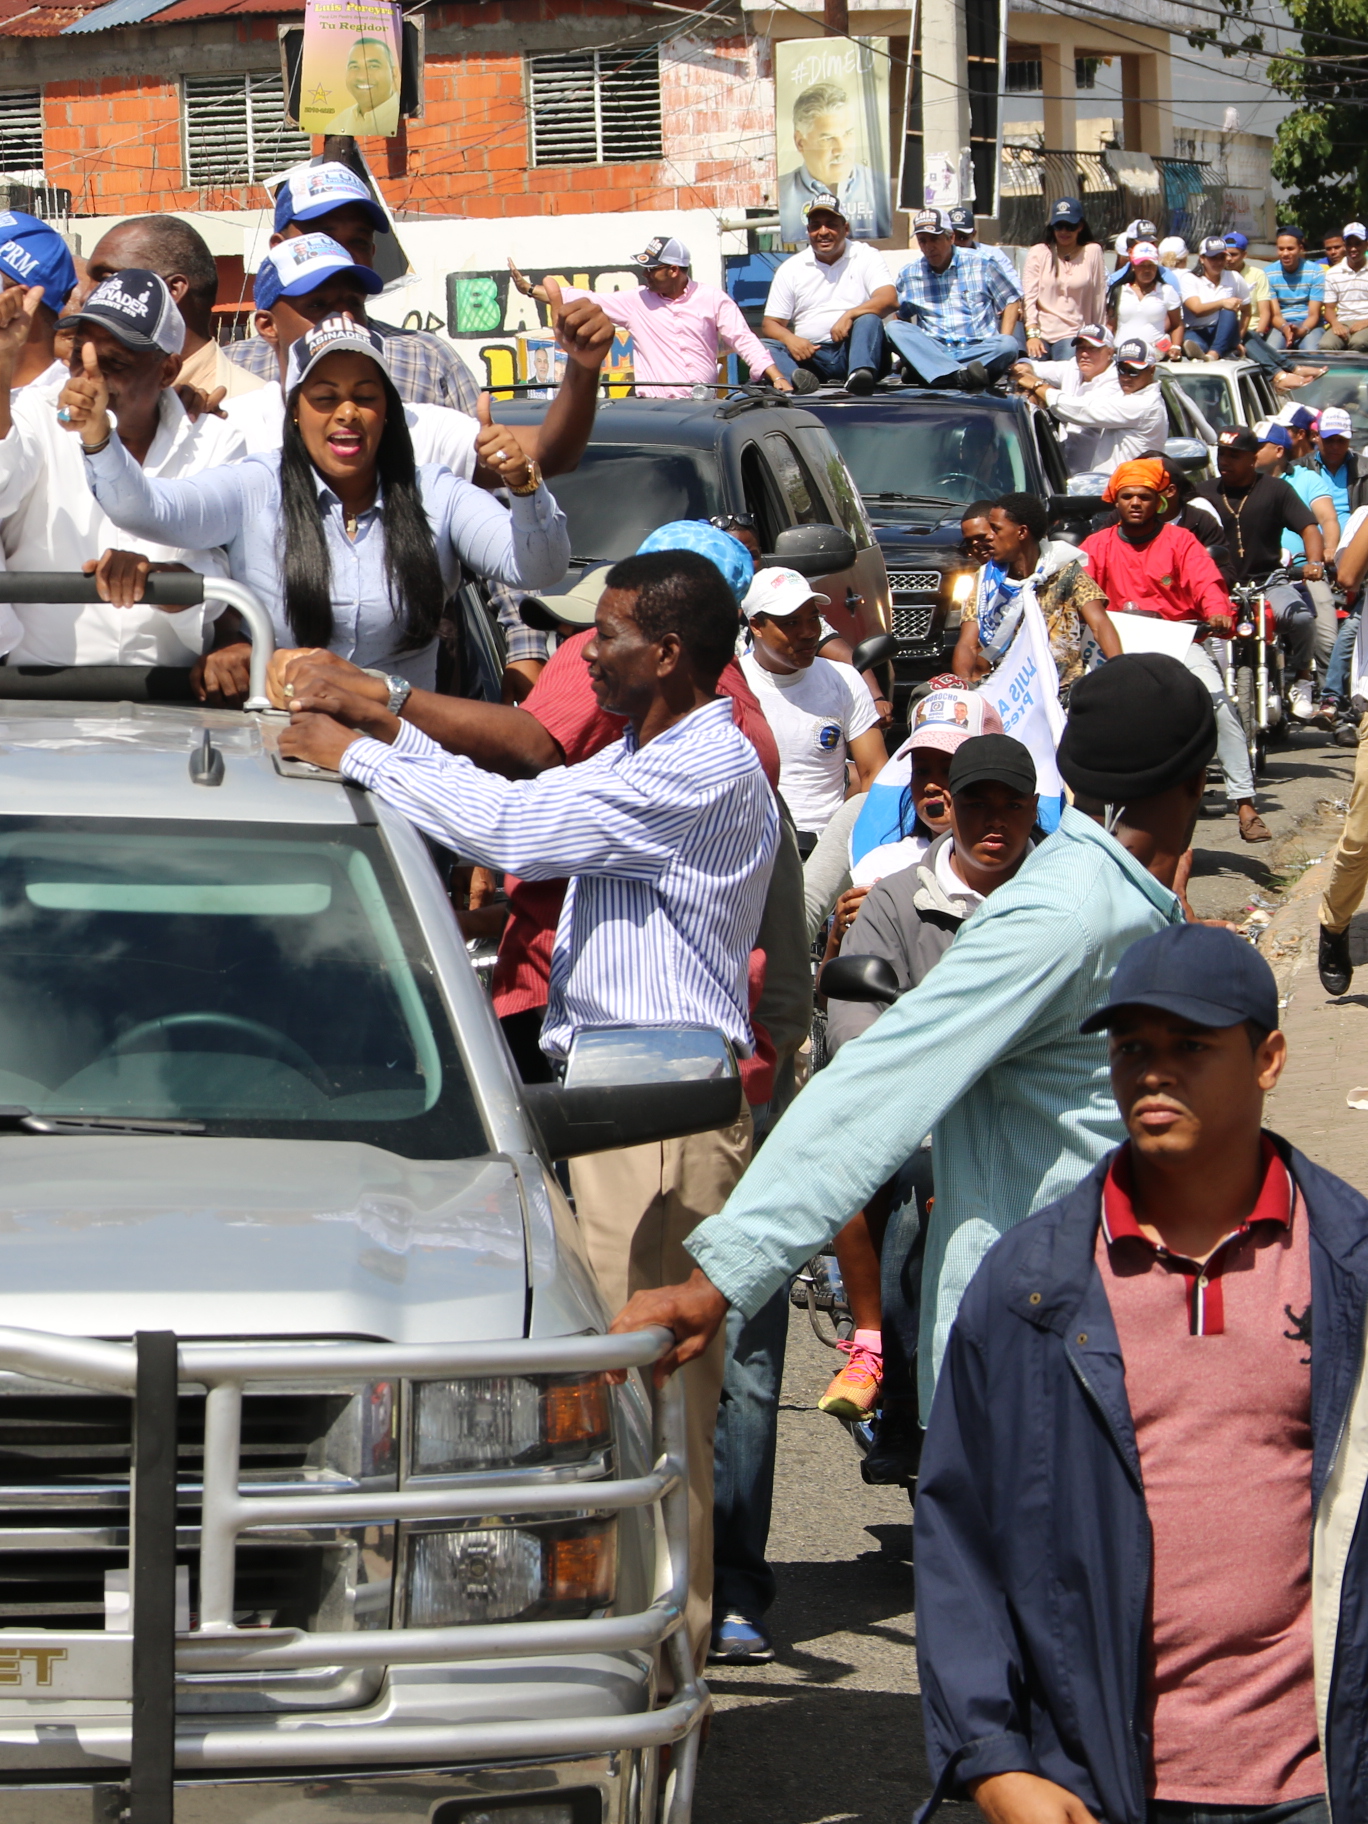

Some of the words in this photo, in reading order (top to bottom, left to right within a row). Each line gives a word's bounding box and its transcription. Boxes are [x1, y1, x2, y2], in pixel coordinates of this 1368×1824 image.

[314, 3, 342, 12] Luis
[346, 2, 395, 15] Pereyra
[319, 21, 336, 30] Tu
[339, 22, 389, 32] Regidor
[841, 202, 873, 214] GUEL
[309, 331, 372, 350] ABINADER
